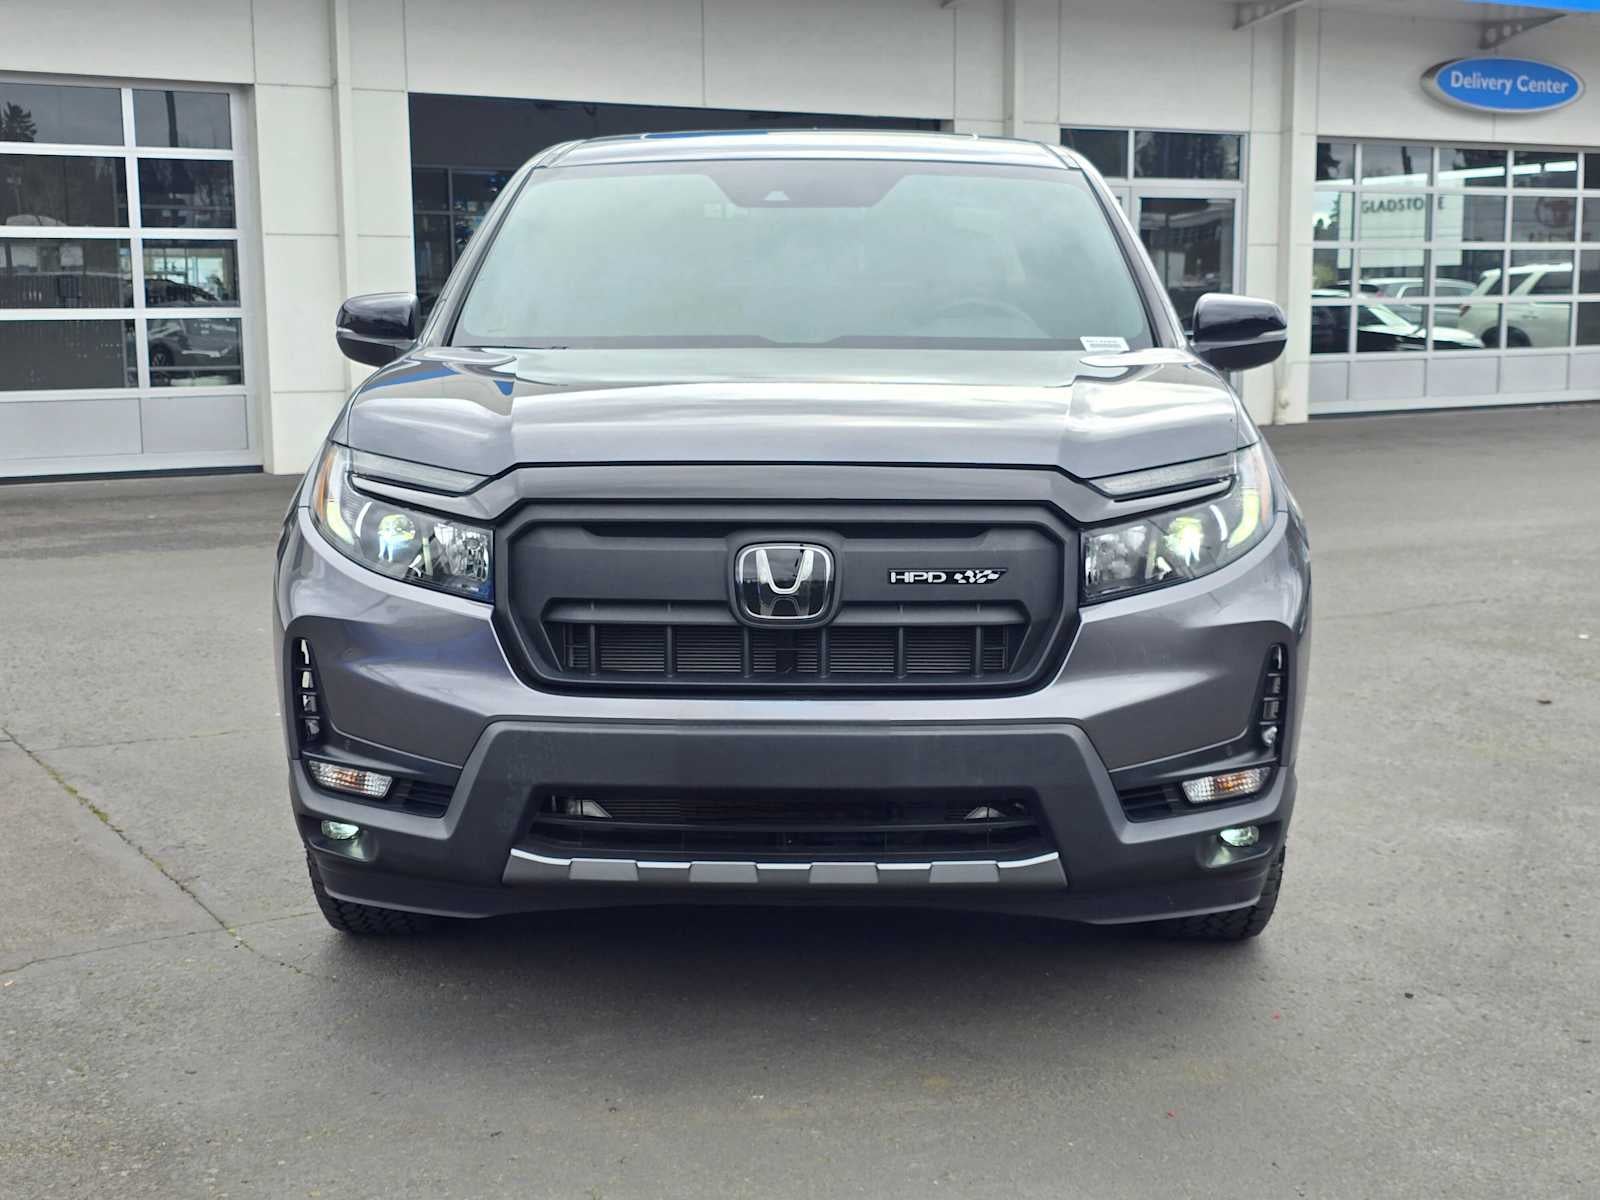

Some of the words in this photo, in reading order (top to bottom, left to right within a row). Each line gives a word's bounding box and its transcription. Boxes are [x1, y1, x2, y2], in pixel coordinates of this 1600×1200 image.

[1450, 71, 1512, 96] Delivery
[1516, 75, 1569, 94] Center
[1361, 197, 1445, 213] GLADSTOE
[890, 571, 947, 583] HPD
